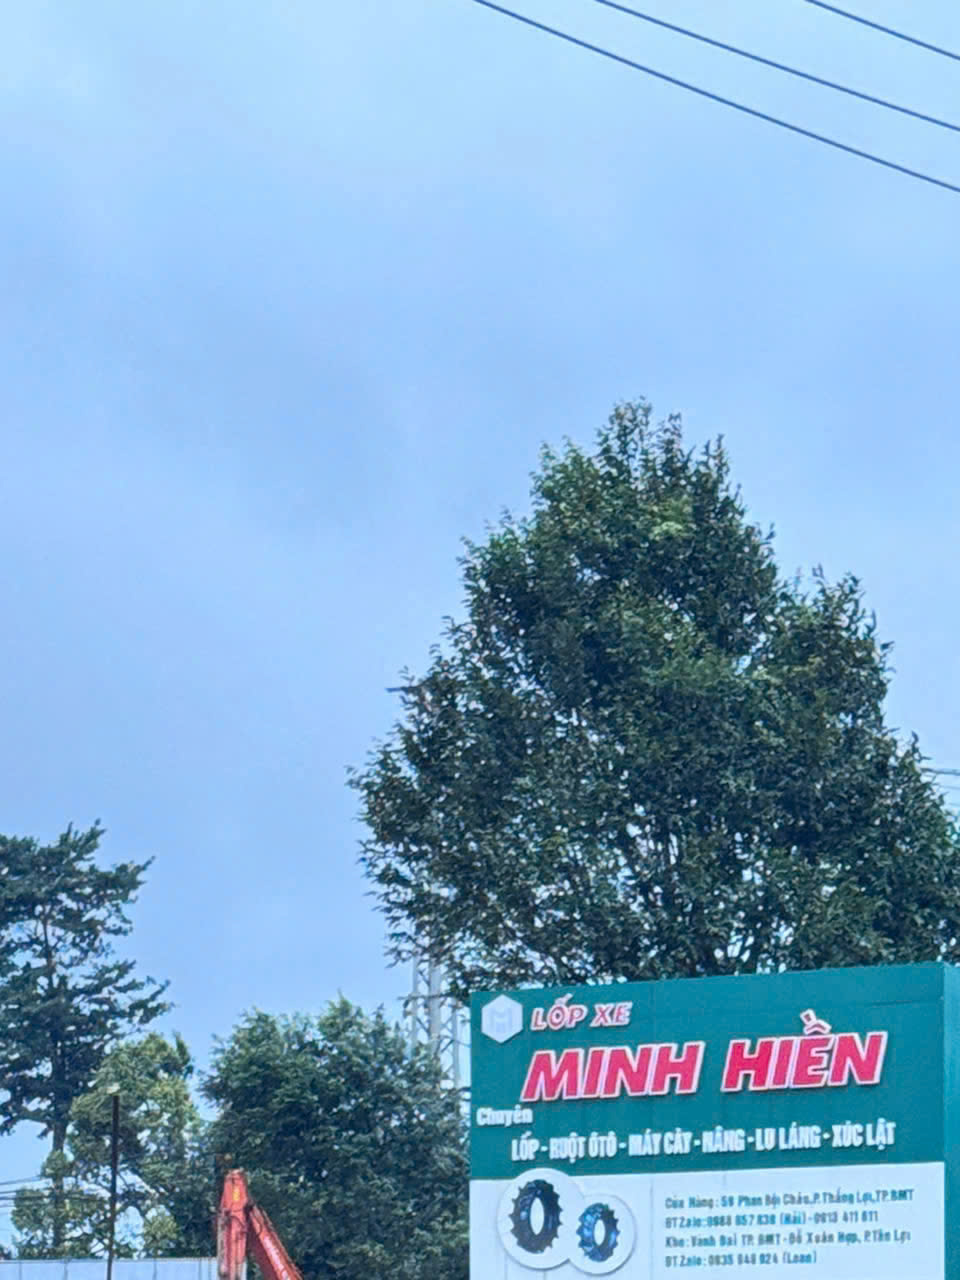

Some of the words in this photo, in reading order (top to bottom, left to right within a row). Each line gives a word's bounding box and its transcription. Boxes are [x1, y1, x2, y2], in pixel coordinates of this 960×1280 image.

[531, 994, 588, 1031] LỐP
[590, 1001, 634, 1027] XE
[520, 1040, 705, 1102] MINH
[720, 1008, 888, 1092] HIỀN
[476, 1104, 533, 1127] Chuyên
[511, 1131, 541, 1161] LỐP
[549, 1132, 587, 1164] RUỘT
[628, 1128, 662, 1156] MÁY
[702, 1125, 745, 1153] NÂNG
[779, 1121, 821, 1150] LÁNG
[832, 1120, 864, 1148] XÚC
[866, 1117, 897, 1150] LẬT
